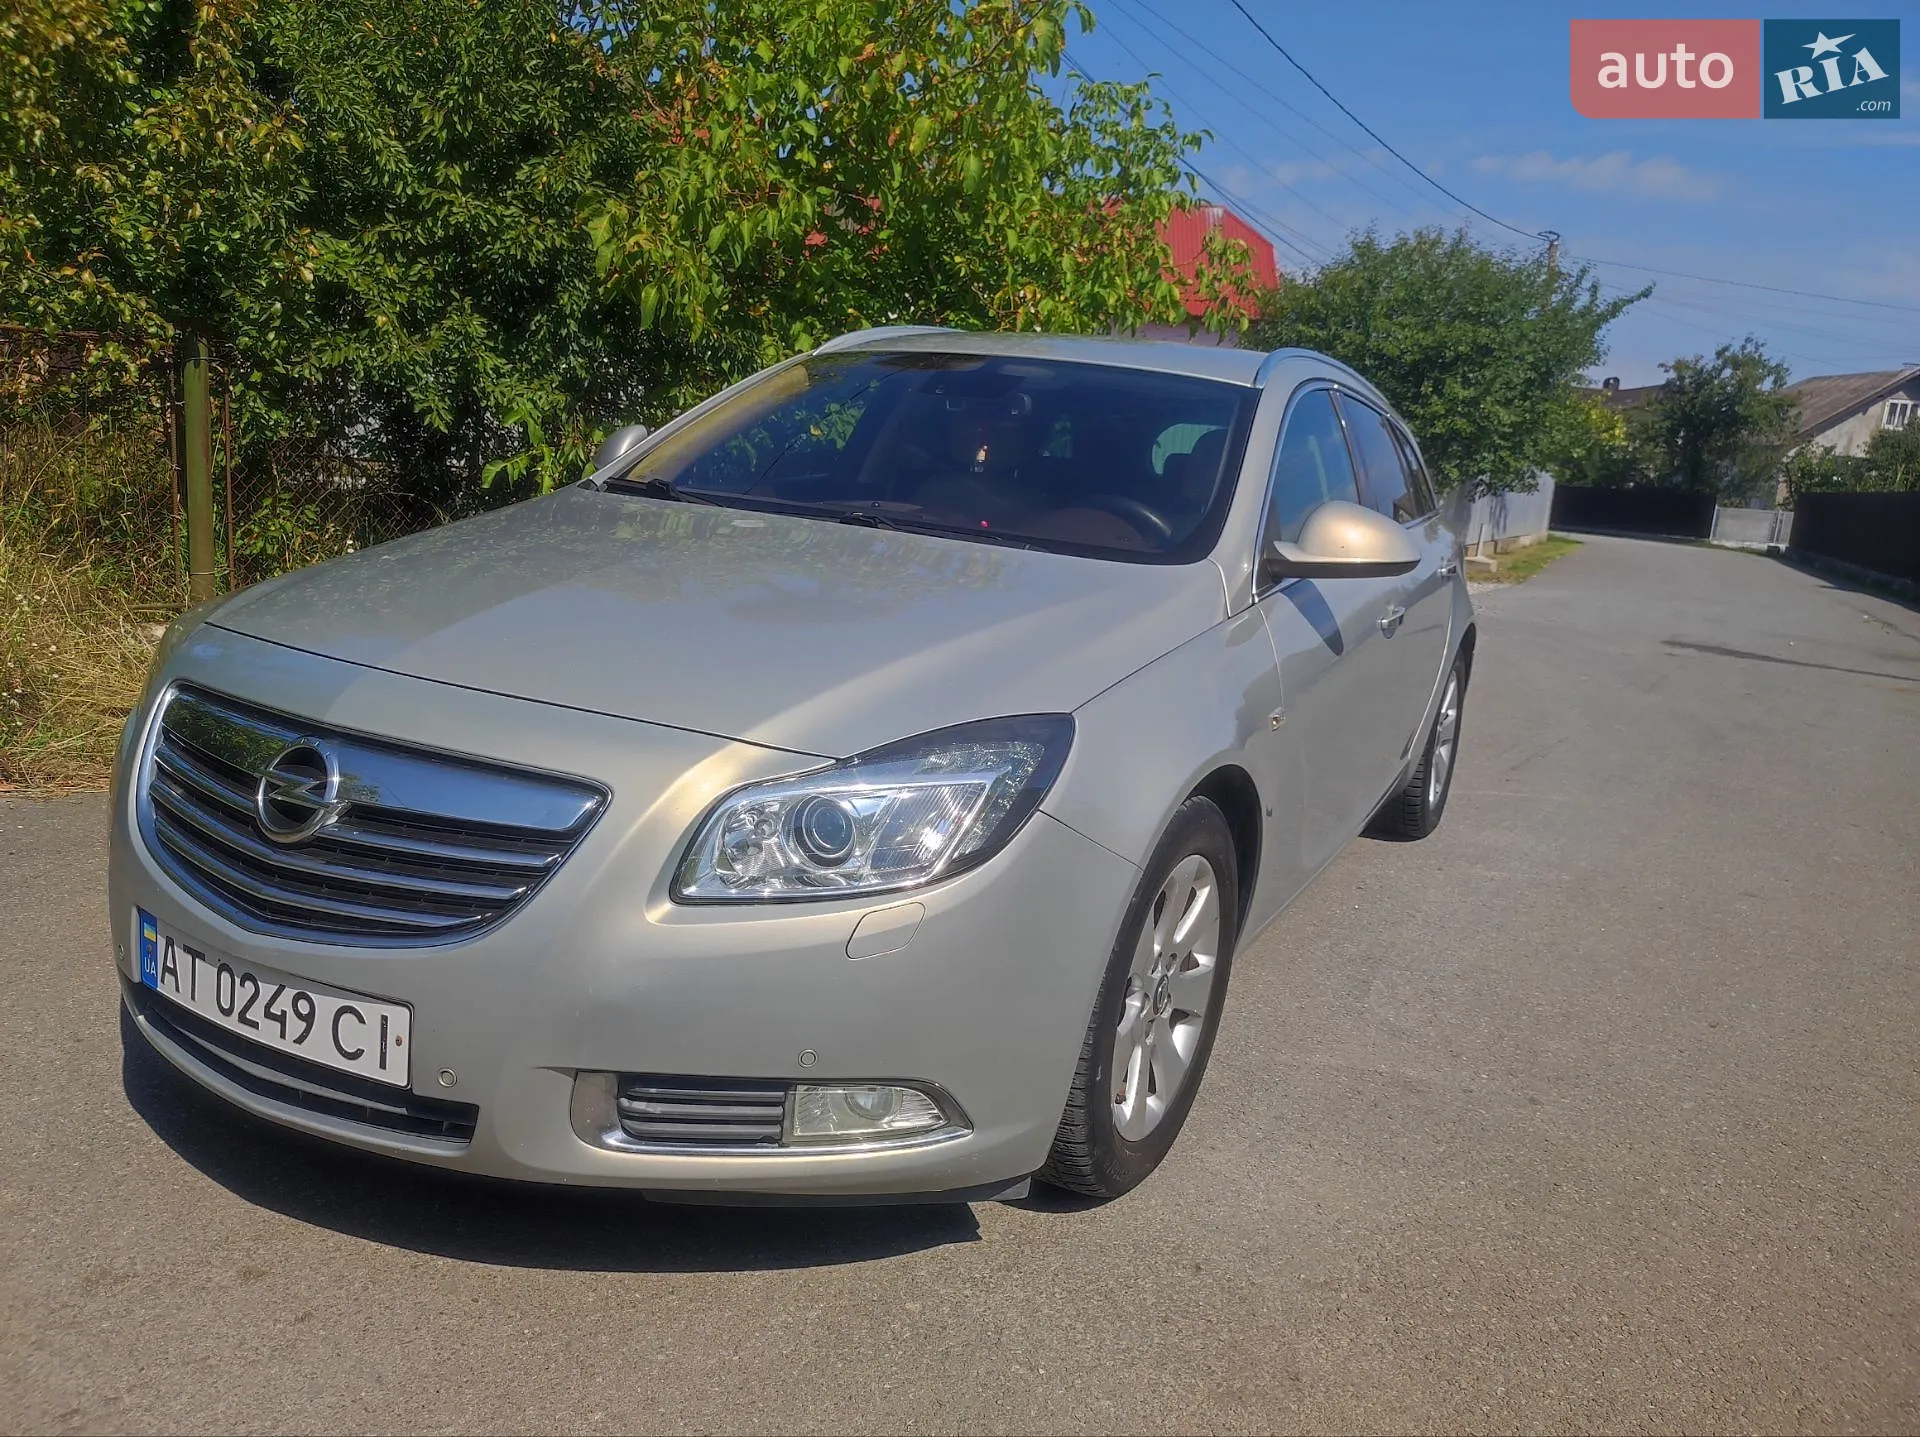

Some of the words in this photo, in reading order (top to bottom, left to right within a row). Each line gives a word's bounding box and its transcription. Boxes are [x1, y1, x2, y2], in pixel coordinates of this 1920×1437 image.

[144, 956, 157, 977] UA
[160, 935, 206, 1001] AT
[216, 962, 317, 1045] 0249
[332, 1004, 389, 1071] CI
